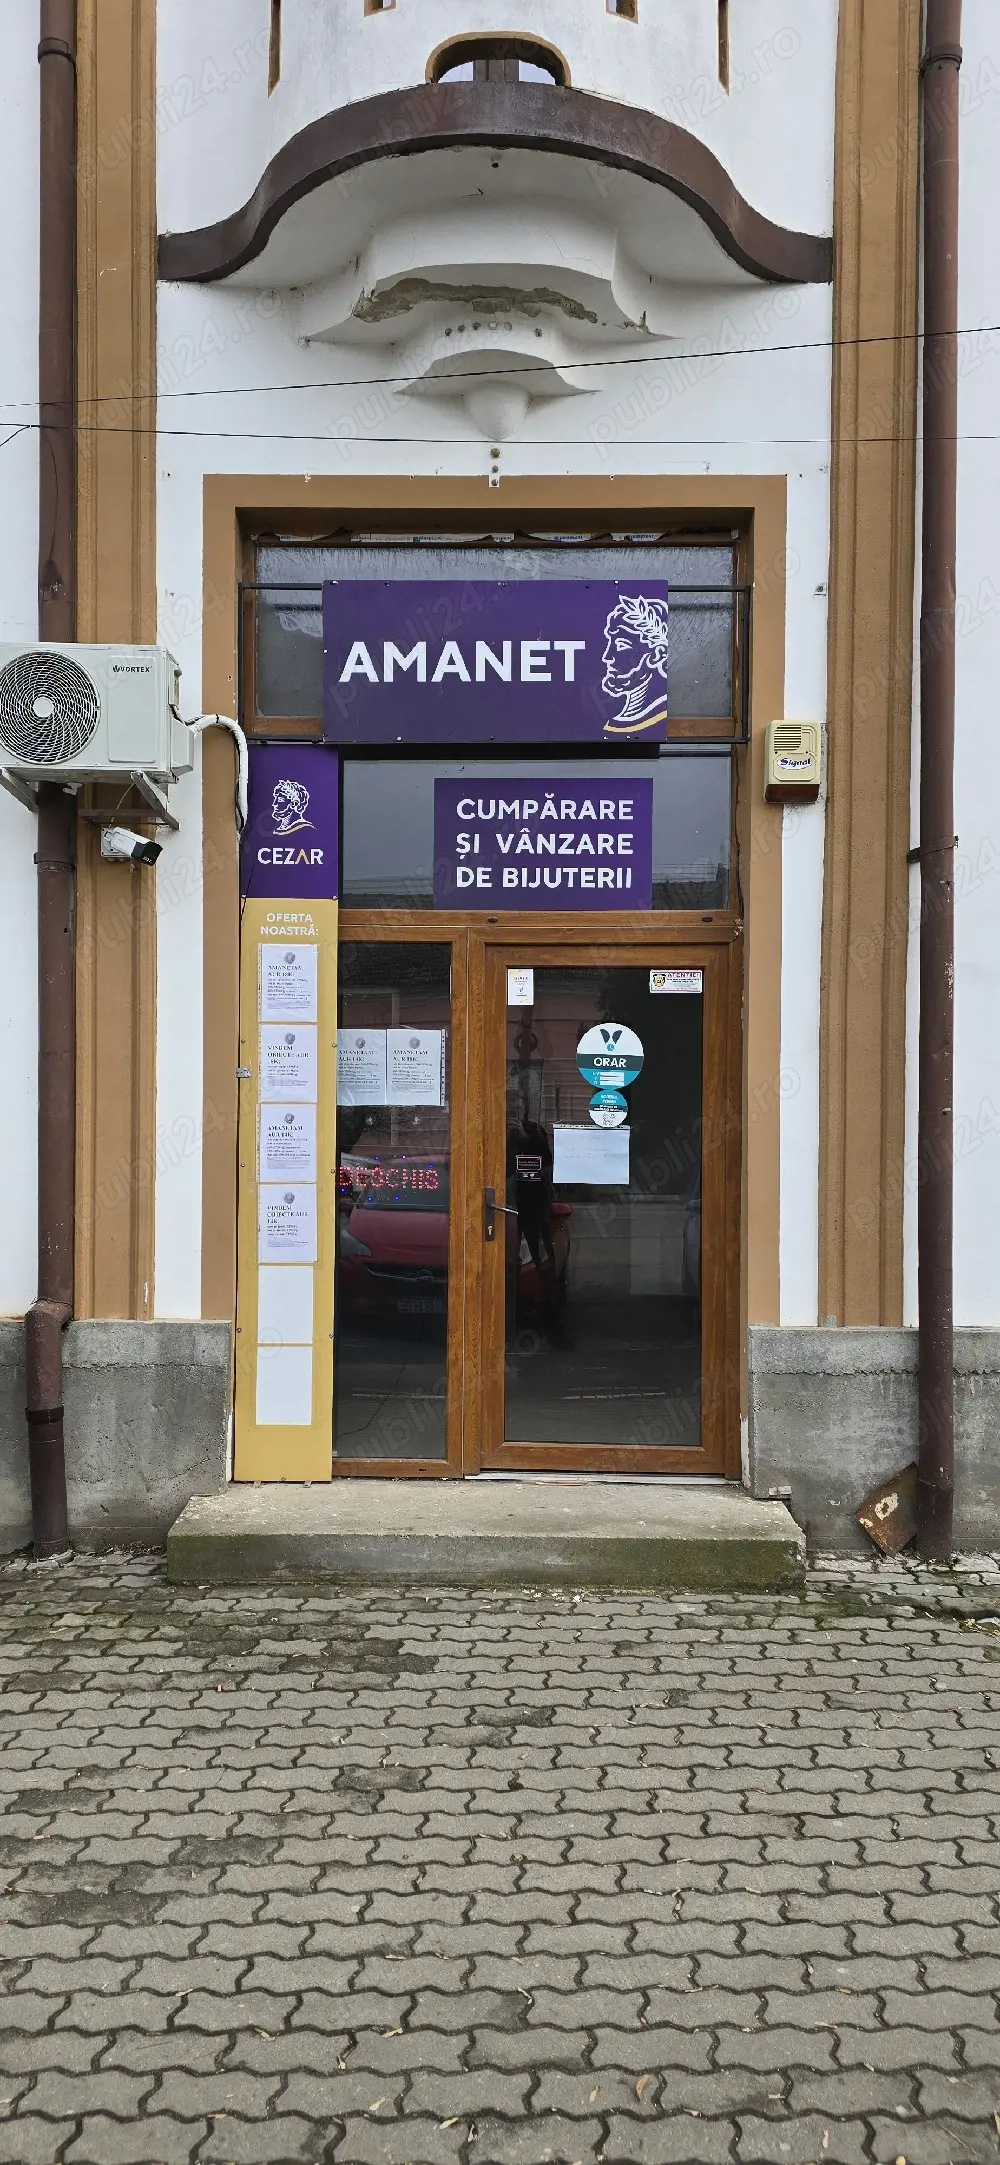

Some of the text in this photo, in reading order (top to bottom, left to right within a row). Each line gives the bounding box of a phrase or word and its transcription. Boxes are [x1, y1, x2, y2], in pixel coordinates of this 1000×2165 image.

[120, 665, 151, 673] VORTEX
[339, 640, 586, 683] AMANET
[780, 757, 811, 768] Signal
[456, 792, 634, 820] CUMPĂRARE
[456, 828, 634, 859] ȘI VÂNZARE
[257, 847, 324, 865] CEZAR
[456, 866, 632, 889] DE BIJUTERII
[266, 912, 313, 923] OFERTA
[260, 922, 319, 937] NOASTRĂ:
[593, 1057, 627, 1068] ORAR
